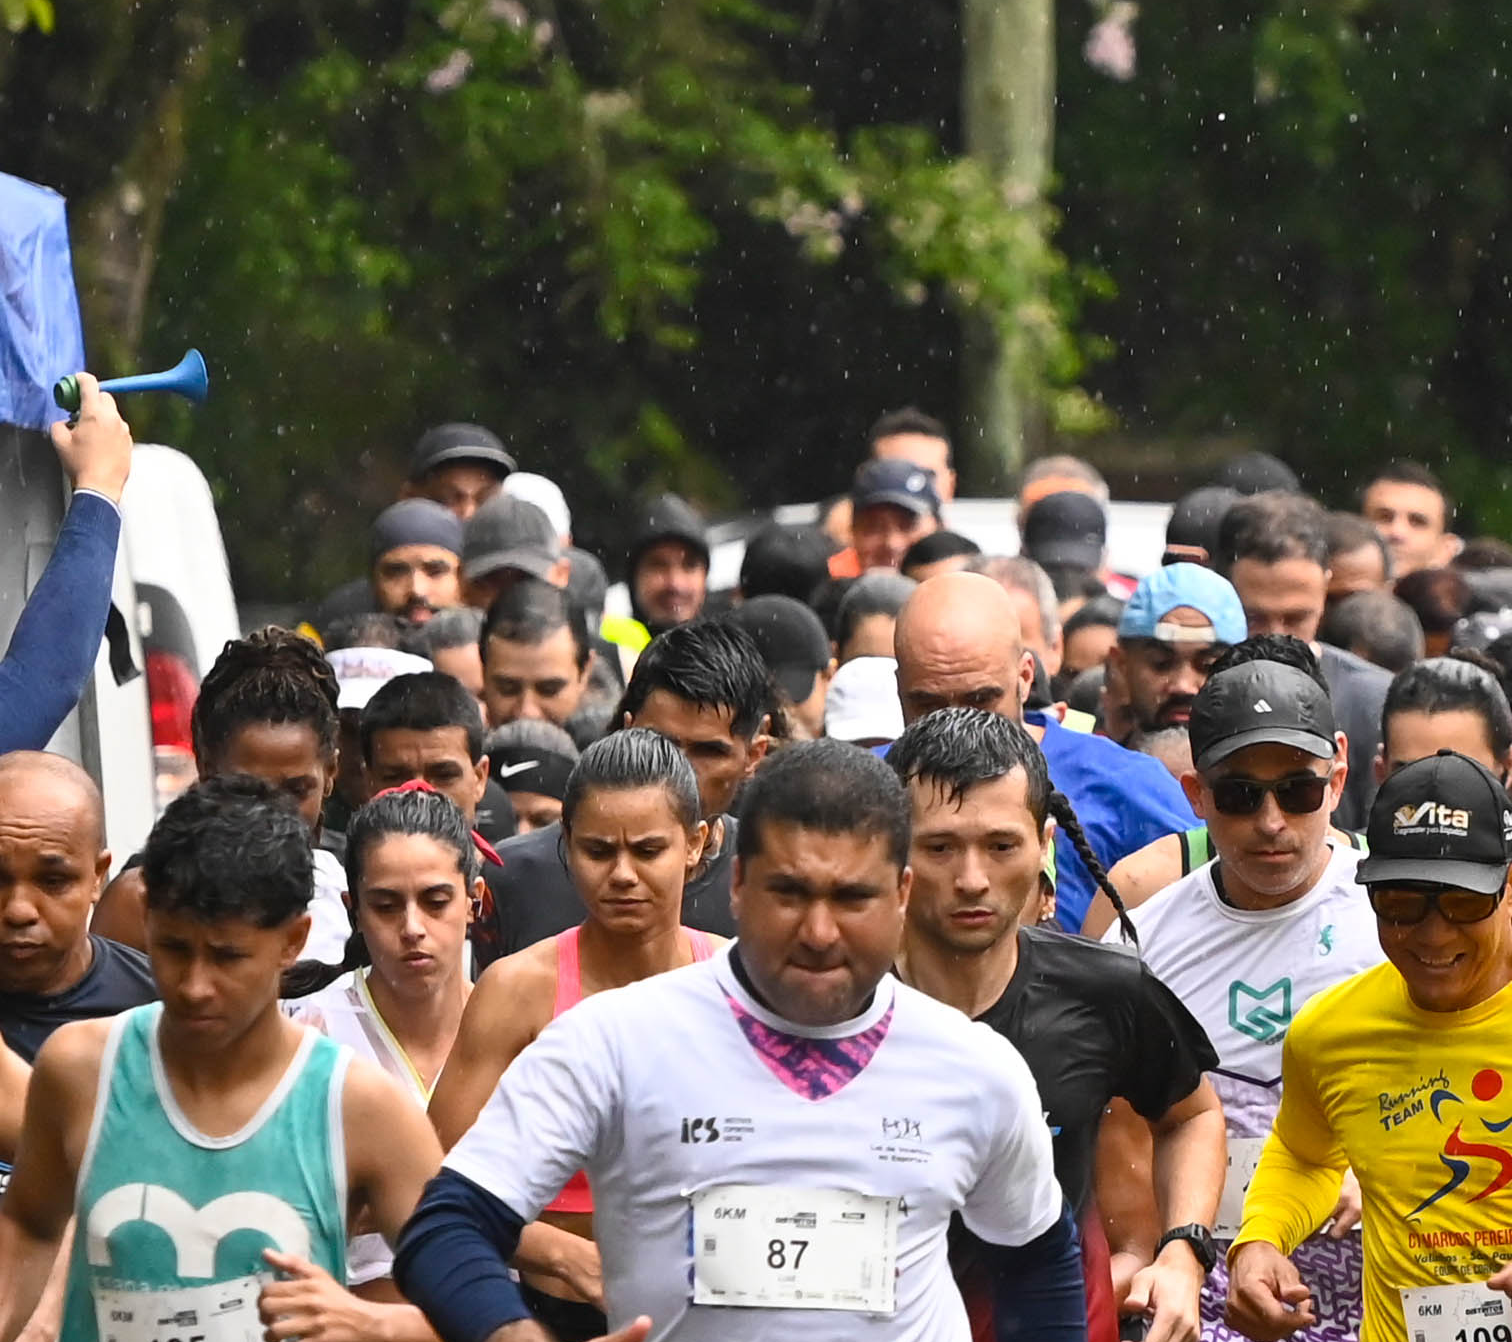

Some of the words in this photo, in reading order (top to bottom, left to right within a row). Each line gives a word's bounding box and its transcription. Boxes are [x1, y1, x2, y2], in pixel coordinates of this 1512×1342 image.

[1379, 1068, 1450, 1114] Running
[1379, 1100, 1424, 1131] TEAM
[714, 1208, 746, 1220] 6KM
[767, 1239, 809, 1270] 87
[1418, 1304, 1442, 1316] 6KM
